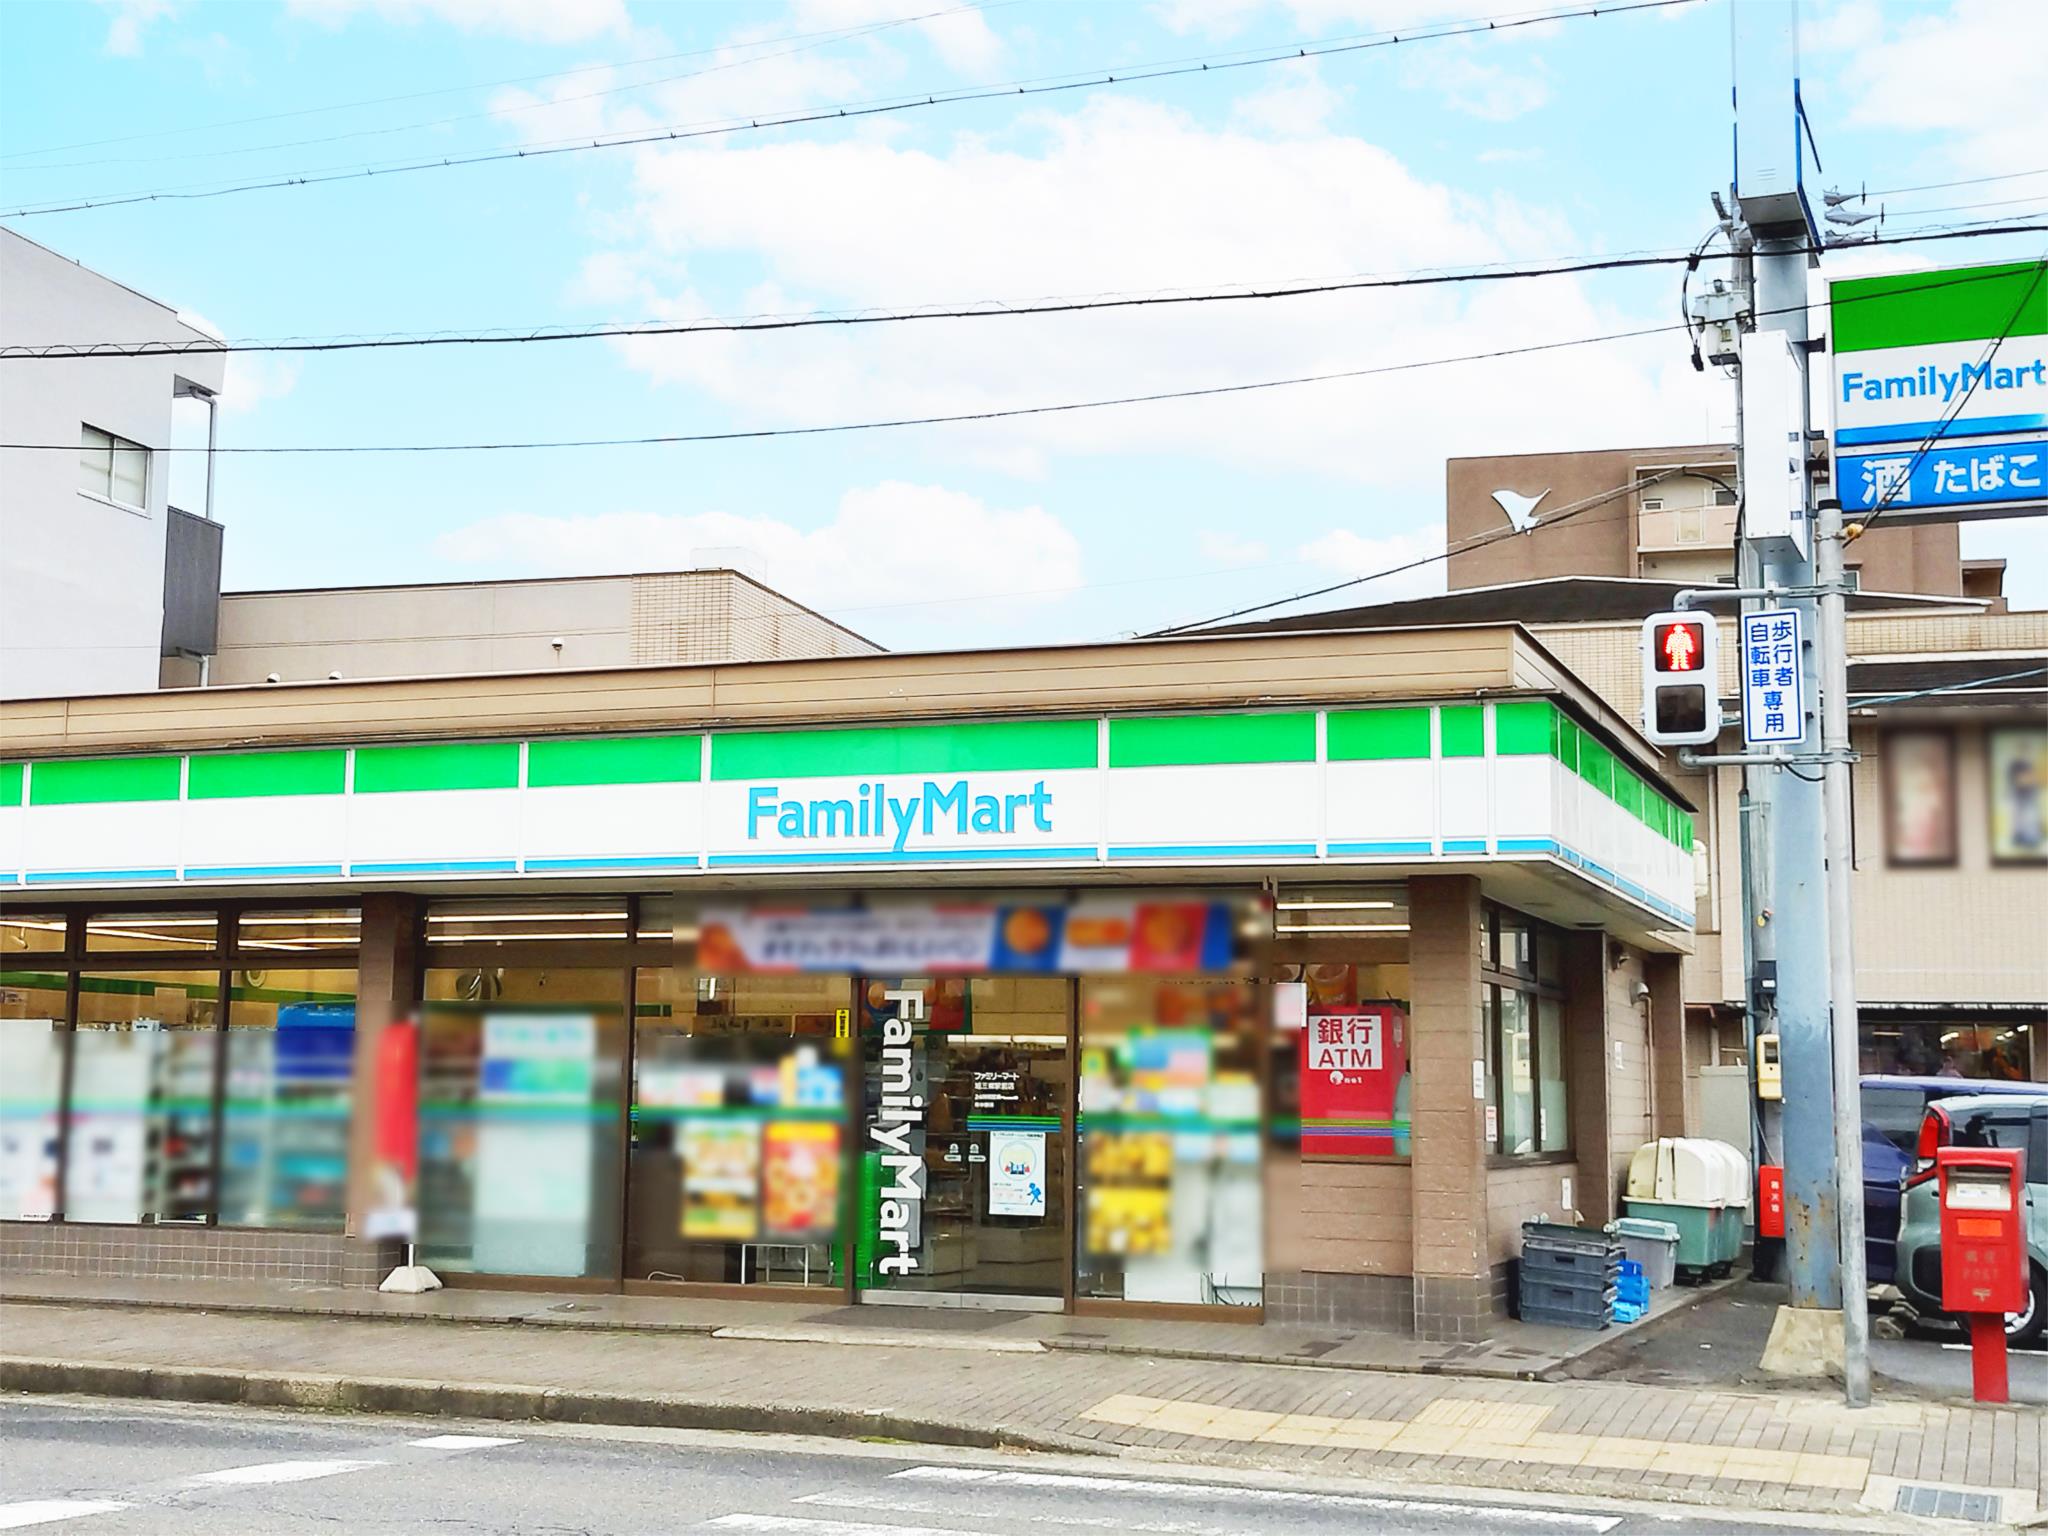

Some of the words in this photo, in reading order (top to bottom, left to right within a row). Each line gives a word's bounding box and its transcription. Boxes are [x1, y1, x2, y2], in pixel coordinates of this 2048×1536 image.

[1842, 358, 2047, 403] FamilyMart
[1860, 456, 1912, 504] 酒
[1932, 454, 2042, 495] たばこ
[1750, 622, 1771, 688] 自転車
[1771, 620, 1794, 687] 歩行者
[1763, 691, 1785, 734] 専用
[747, 780, 1053, 853] FamilyMart
[1317, 1017, 1373, 1045] 銀行
[1318, 1048, 1372, 1068] ATM
[869, 989, 925, 1276] FamilyMart
